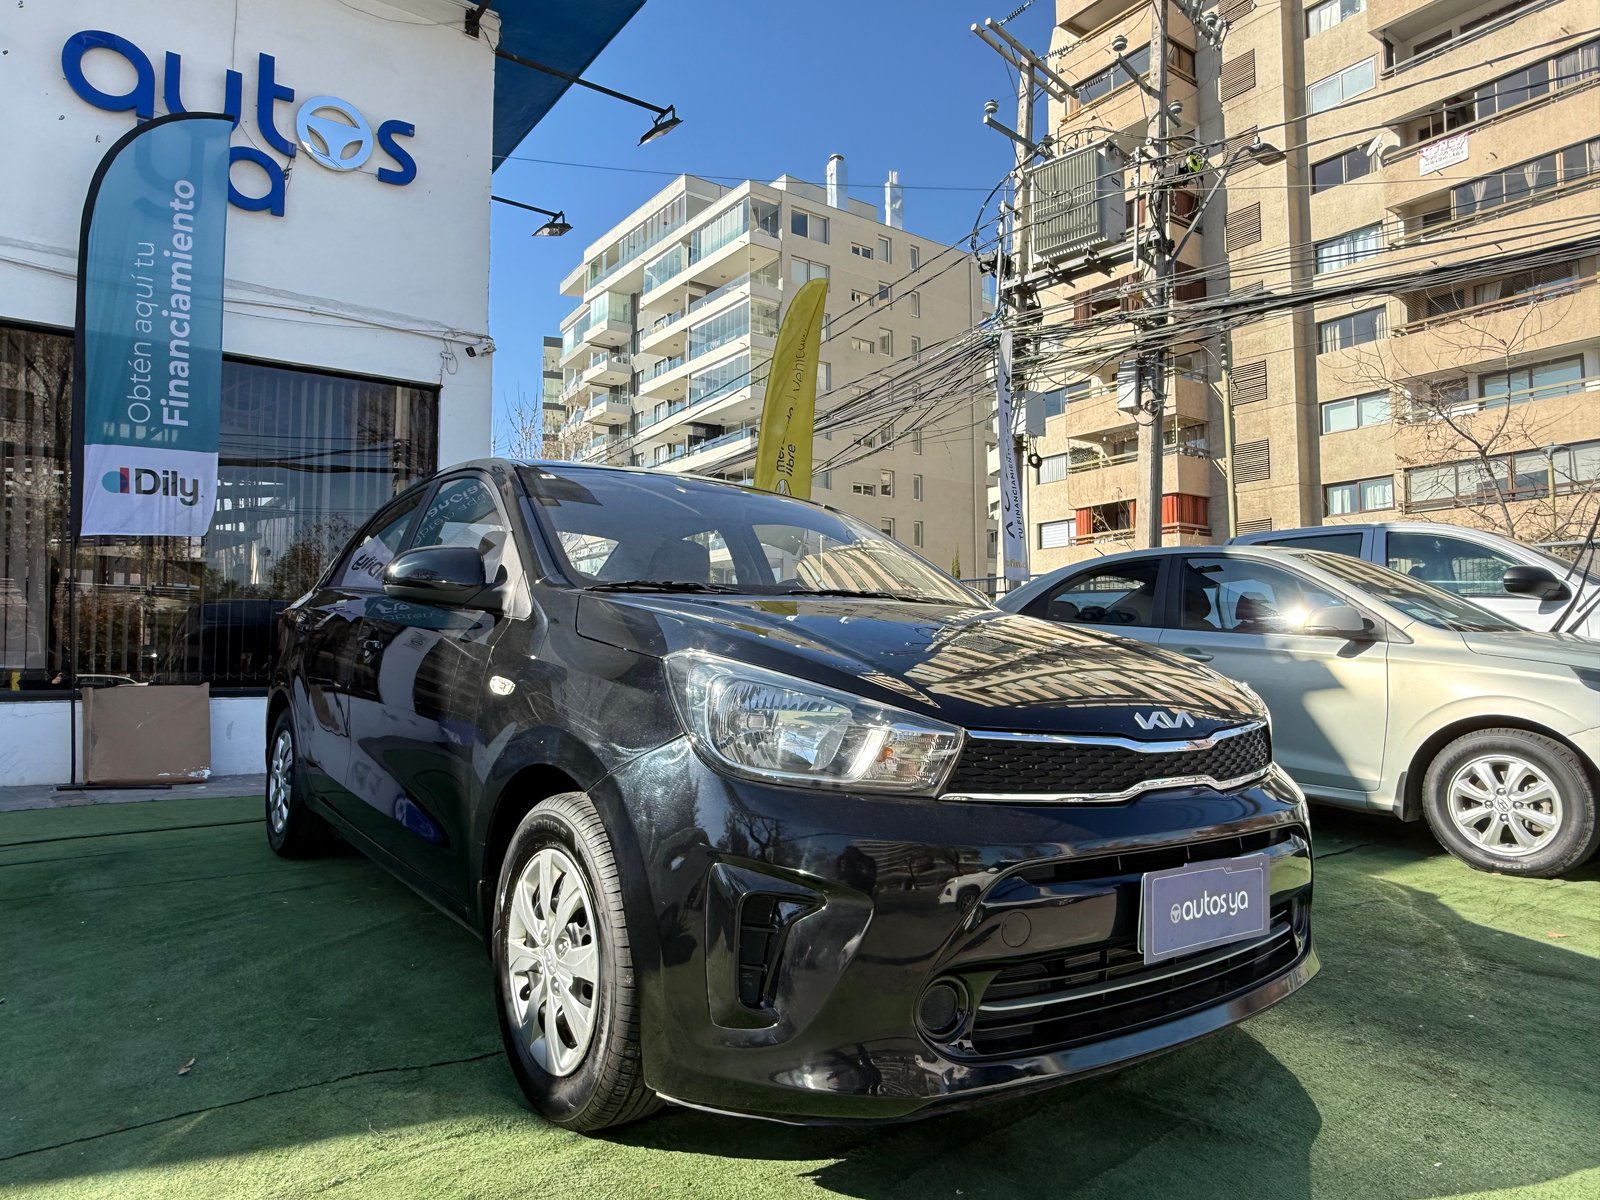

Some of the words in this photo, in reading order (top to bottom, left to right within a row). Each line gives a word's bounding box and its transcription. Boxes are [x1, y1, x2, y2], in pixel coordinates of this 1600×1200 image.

[134, 242, 155, 268] tu
[130, 274, 158, 333] aquí
[160, 179, 195, 427] Financiamiento
[127, 342, 151, 423] Obtén
[135, 468, 198, 506] Dily
[1182, 890, 1227, 920] autos
[1228, 890, 1249, 916] ya
